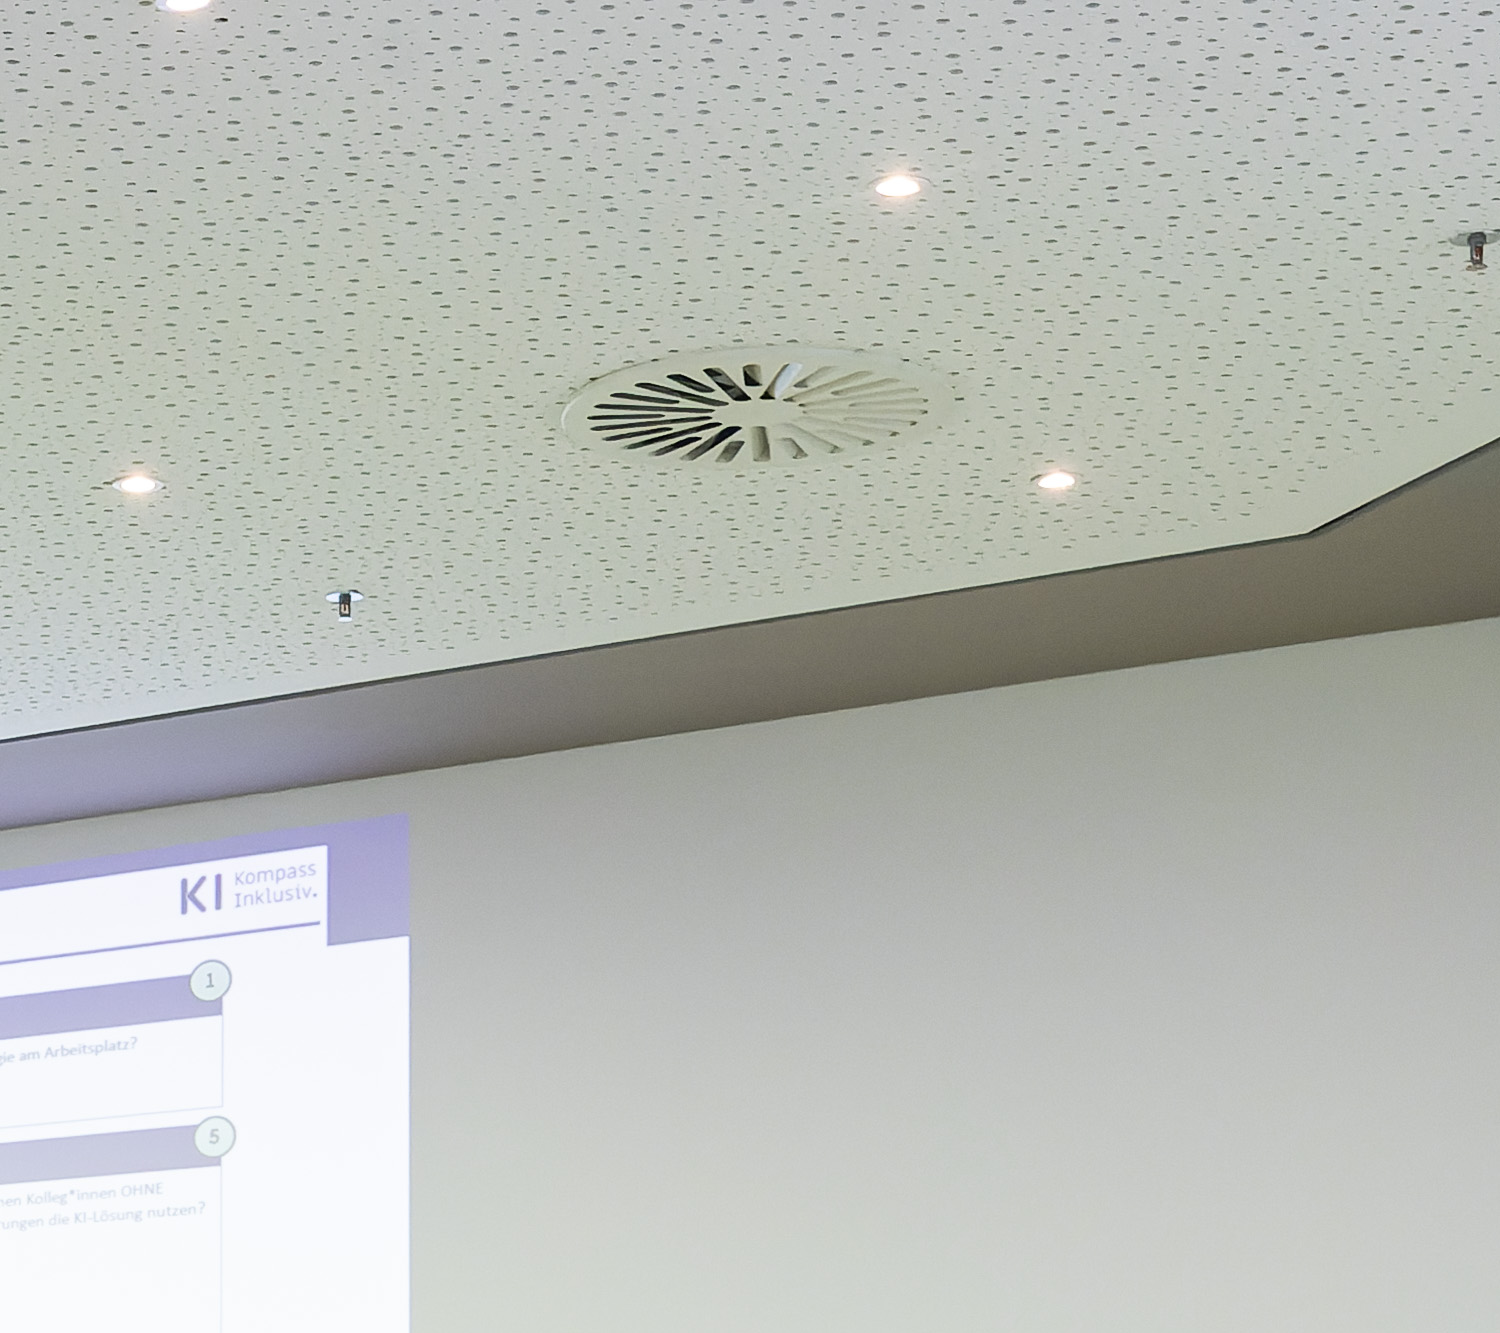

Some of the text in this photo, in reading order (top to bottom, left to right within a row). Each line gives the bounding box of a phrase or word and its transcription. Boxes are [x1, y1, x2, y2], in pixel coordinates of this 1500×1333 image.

[233, 862, 317, 886] Kompass
[178, 872, 224, 917] KI
[233, 885, 319, 908] Inklusiv.
[205, 972, 215, 989] 1
[208, 1128, 220, 1145] 5
